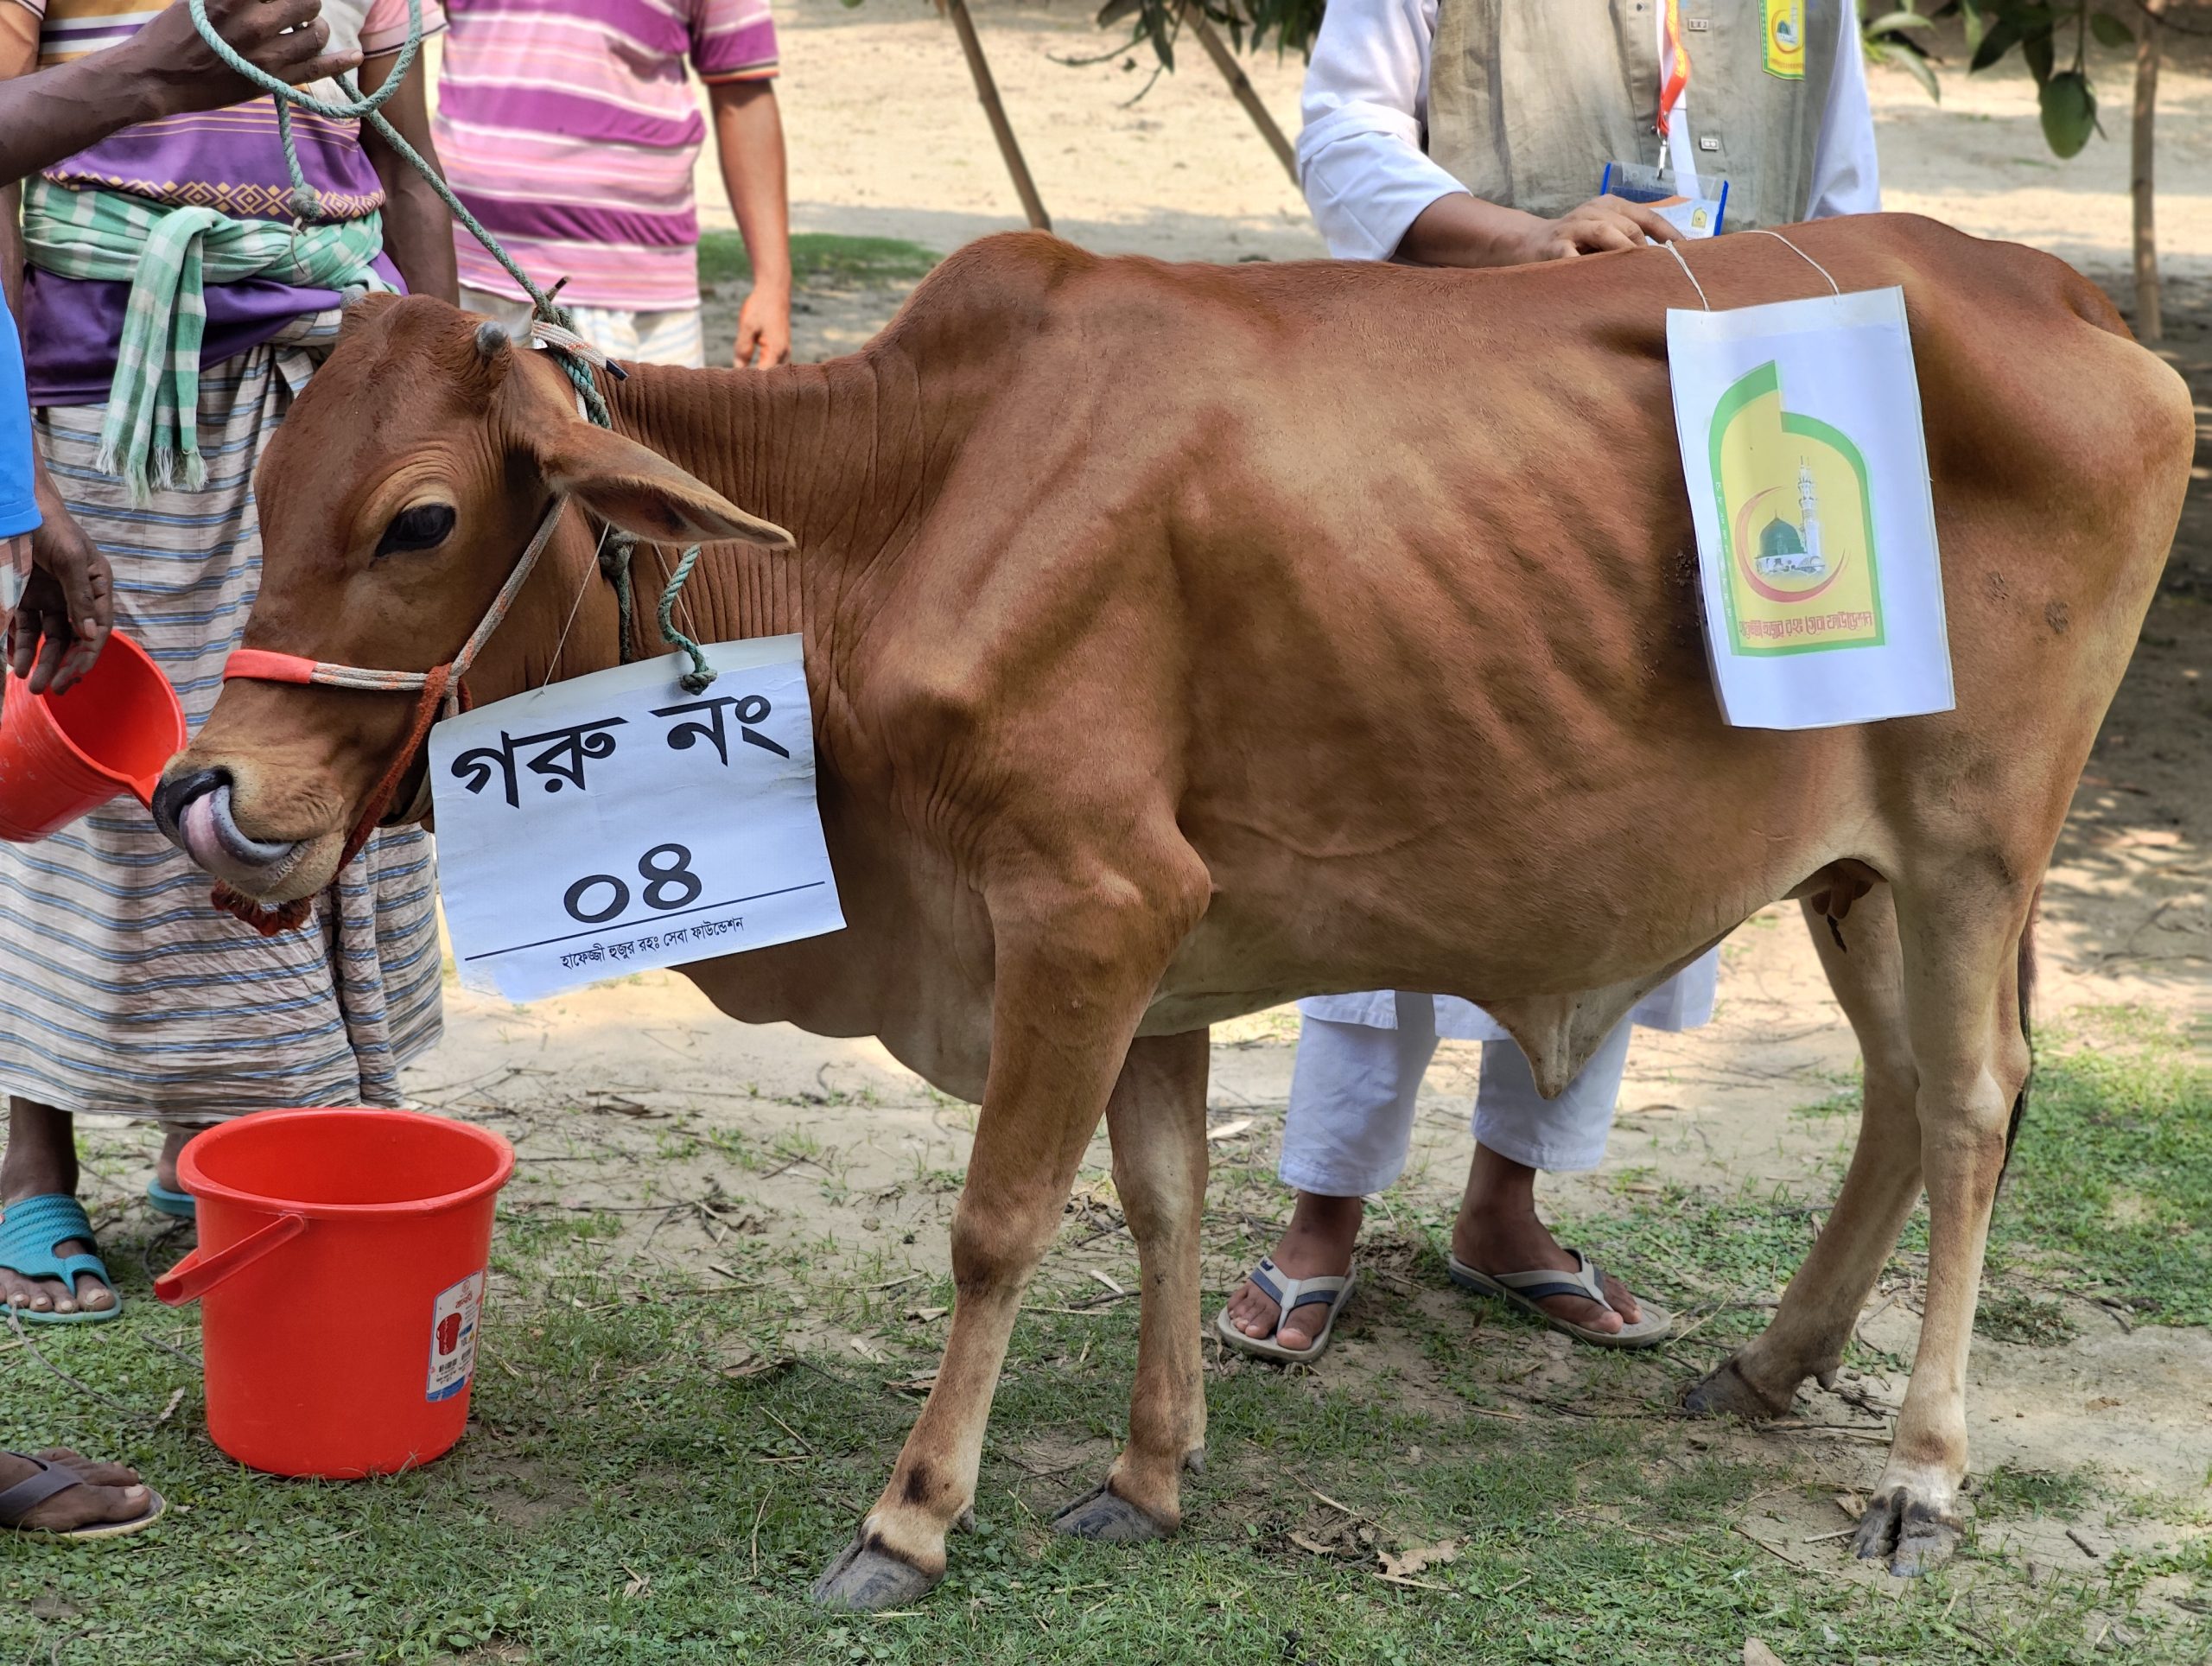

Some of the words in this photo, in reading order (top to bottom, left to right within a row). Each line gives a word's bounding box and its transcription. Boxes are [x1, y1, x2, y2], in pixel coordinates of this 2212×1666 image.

[452, 717, 629, 809] গরু
[649, 695, 790, 766] নং
[563, 843, 702, 924] ০৪
[560, 944, 605, 970] হাফেজ্জী
[609, 941, 635, 959] হুজুর
[664, 929, 688, 946] সেবা
[691, 918, 744, 939] ফাউন্ডেশন
